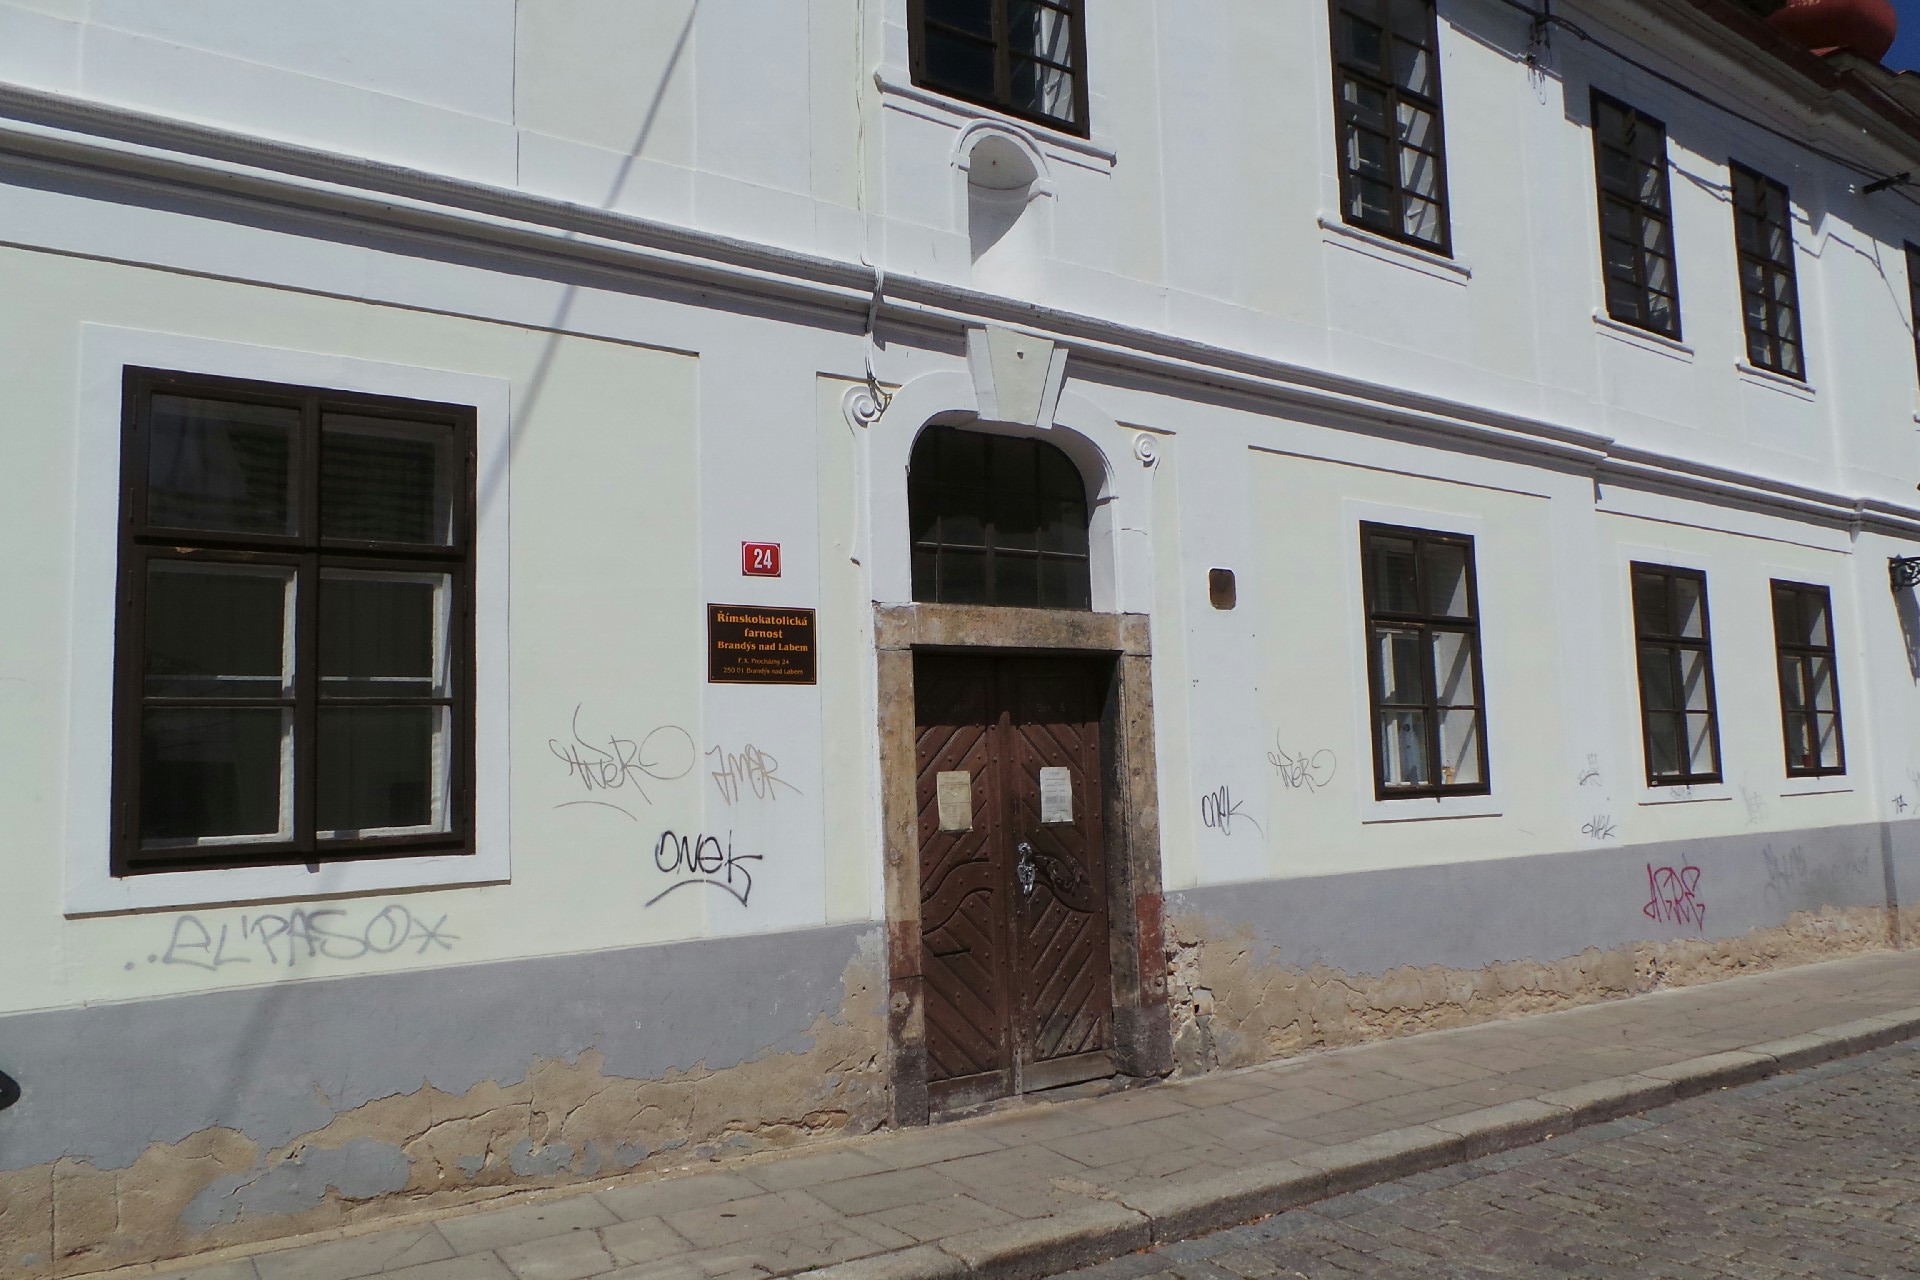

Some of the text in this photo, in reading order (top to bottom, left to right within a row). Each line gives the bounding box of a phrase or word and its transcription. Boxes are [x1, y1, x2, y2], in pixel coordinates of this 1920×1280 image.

[753, 548, 773, 569] 24
[717, 610, 808, 626] Římskokatolická
[744, 627, 783, 639] farnost
[717, 641, 808, 652] Brandýs nad Labem
[746, 667, 770, 676] Brandýs
